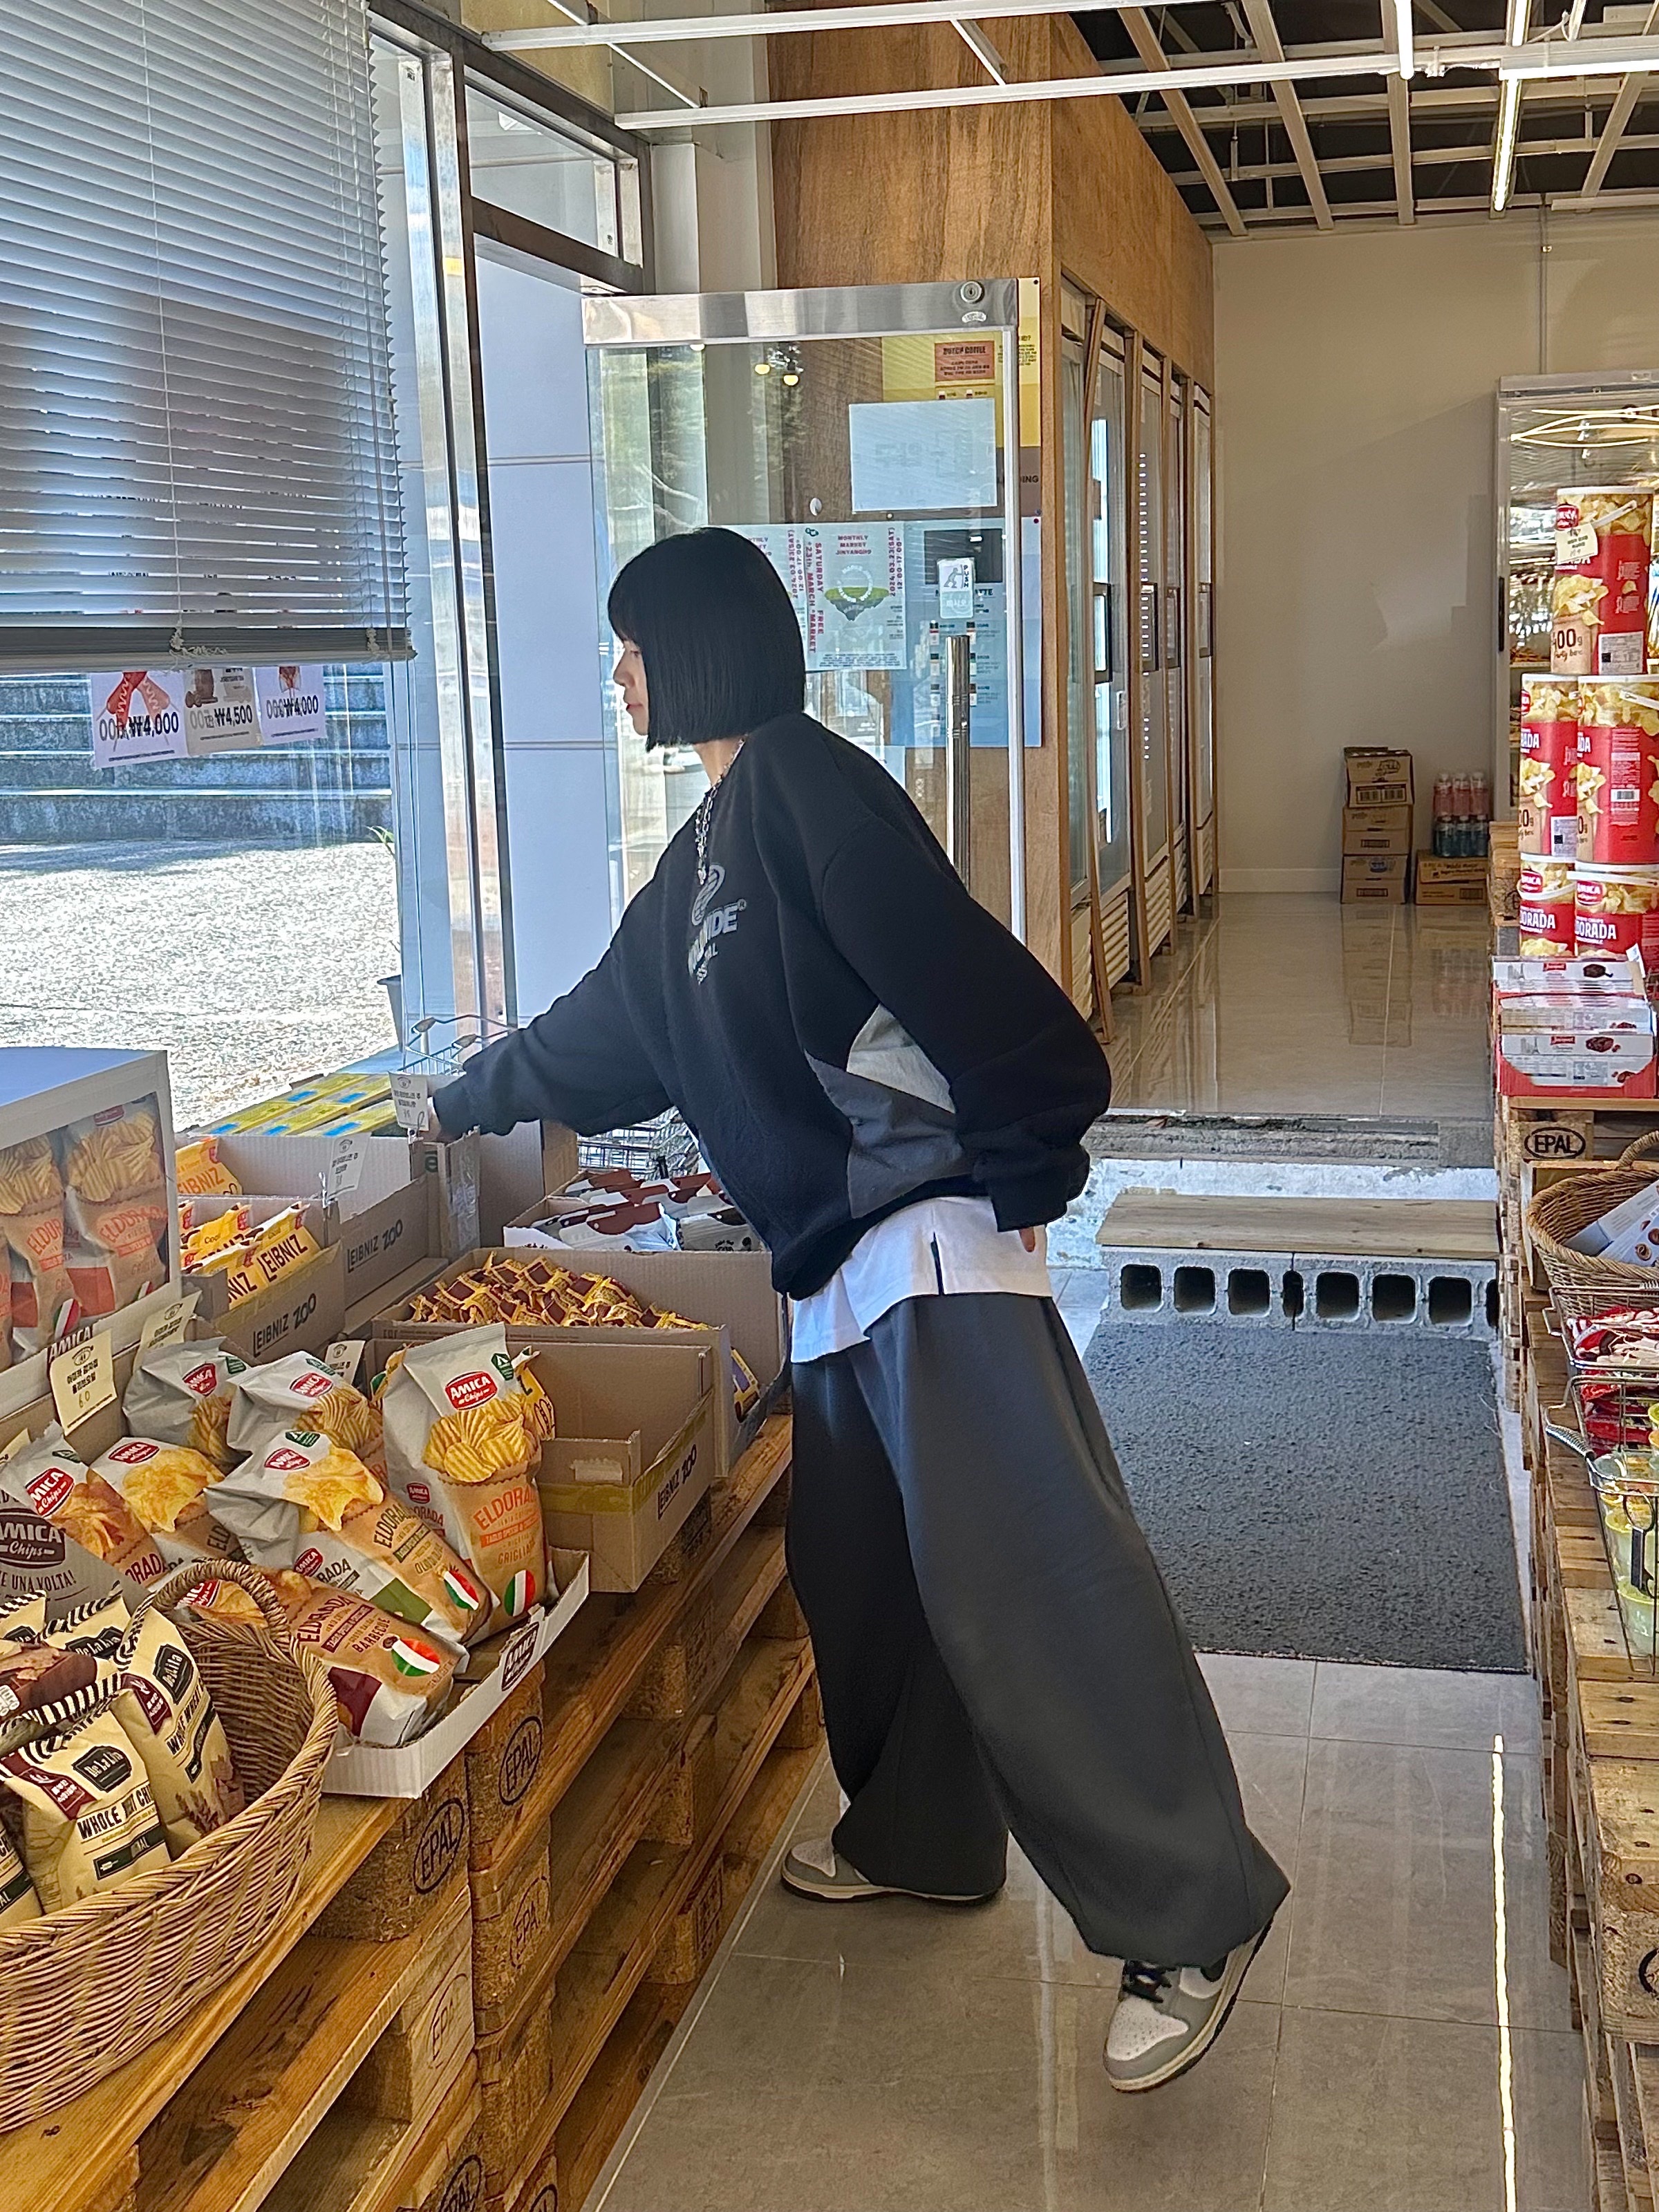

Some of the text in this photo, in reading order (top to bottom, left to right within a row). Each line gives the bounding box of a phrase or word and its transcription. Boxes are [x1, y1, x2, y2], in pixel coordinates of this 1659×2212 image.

[815, 543, 824, 592] SATURDAY
[807, 572, 816, 606] MARCH
[1535, 1134, 1578, 1154] EPAL
[177, 1167, 225, 1194] EIBNIZ
[256, 1234, 308, 1282] LEIBNIZ
[347, 1219, 404, 1273] LEIBNIZ ZOO
[253, 1293, 317, 1358] LEIBNIZ ZOO
[48, 1326, 91, 1363] AMICA
[451, 1376, 491, 1400] AMICA
[464, 1389, 484, 1403] Chips
[30, 1471, 64, 1505] MICA
[41, 1488, 62, 1508] Chips
[9, 1541, 44, 1559] Chips
[12, 1575, 35, 1593] UNA
[36, 1570, 77, 1591] VOLTA!
[505, 1731, 537, 1795] EPAL
[77, 1806, 122, 1839] WHOLE
[422, 1806, 458, 1884] EPAL
